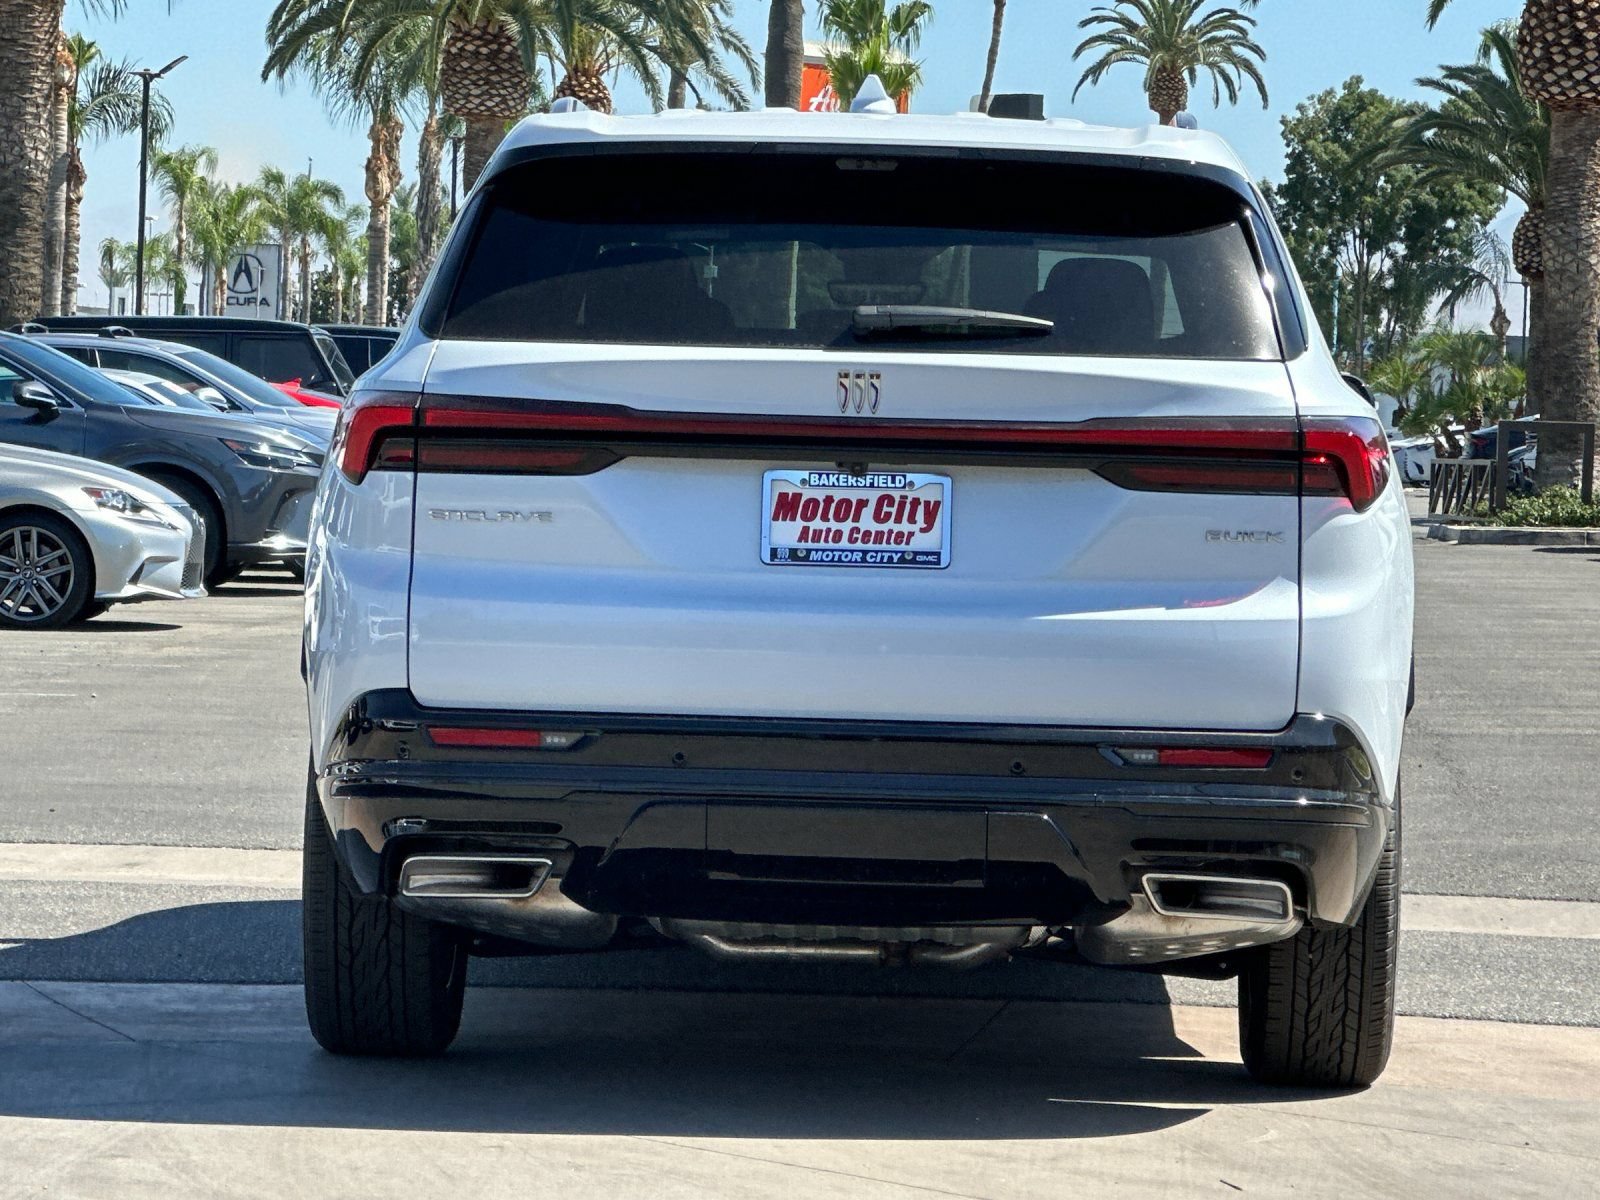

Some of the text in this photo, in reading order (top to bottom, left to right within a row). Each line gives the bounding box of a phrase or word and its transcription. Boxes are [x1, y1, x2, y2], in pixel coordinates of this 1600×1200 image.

[225, 296, 271, 307] CURA
[809, 473, 905, 488] BAKERSFIELD
[428, 508, 553, 522] ENCLAVE
[771, 491, 942, 533] Motor City
[797, 525, 916, 545] Auto Center
[1205, 529, 1286, 544] BUICK
[809, 550, 902, 563] MOTOR CITY
